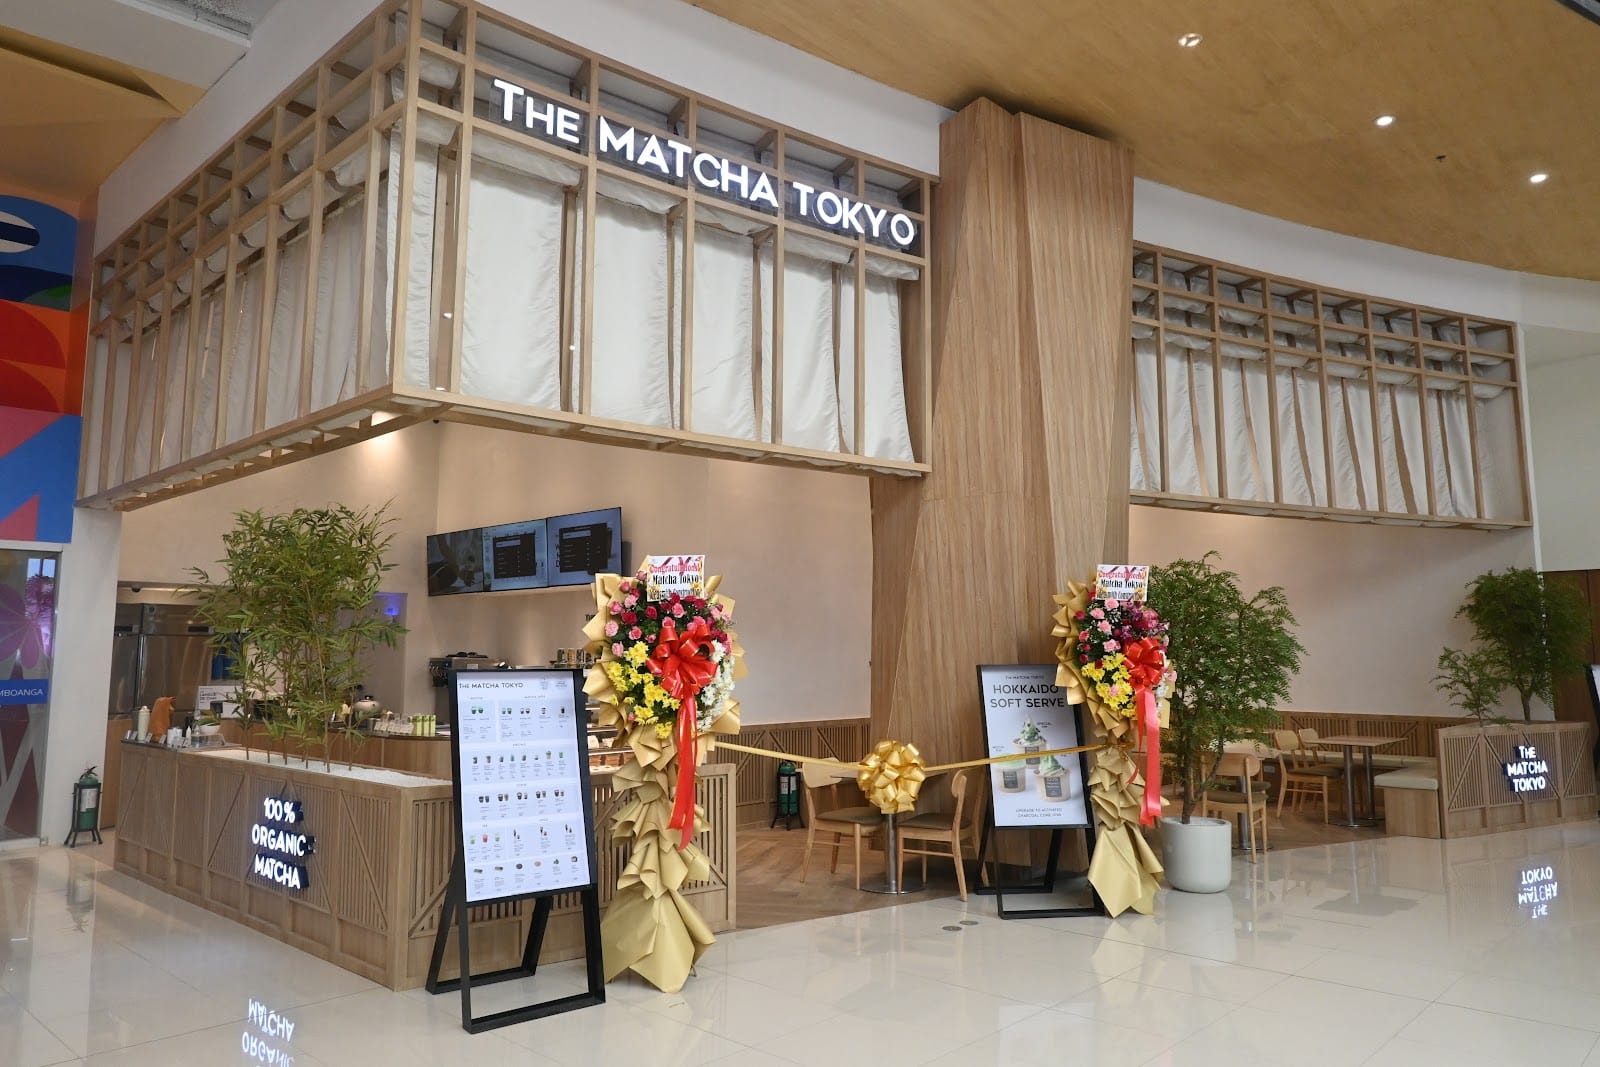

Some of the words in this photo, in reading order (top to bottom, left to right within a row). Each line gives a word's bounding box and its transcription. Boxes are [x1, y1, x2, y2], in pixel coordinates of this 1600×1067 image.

[493, 79, 580, 144] THE
[599, 115, 779, 208] MATCHA
[792, 181, 915, 246] TOKYO
[652, 574, 677, 585] Matcha
[678, 574, 699, 585] Tokyo
[1100, 579, 1123, 588] Matcha
[993, 684, 1059, 694] HOKKAIDO
[990, 698, 1021, 708] SOFT
[1026, 698, 1065, 708] SERVE
[1518, 745, 1537, 759] THE
[1507, 759, 1548, 777] MATCHA
[1512, 775, 1546, 793] TOKYO
[263, 797, 296, 824] 100%
[251, 823, 307, 857] ORGANIC
[254, 853, 301, 890] MATCHA
